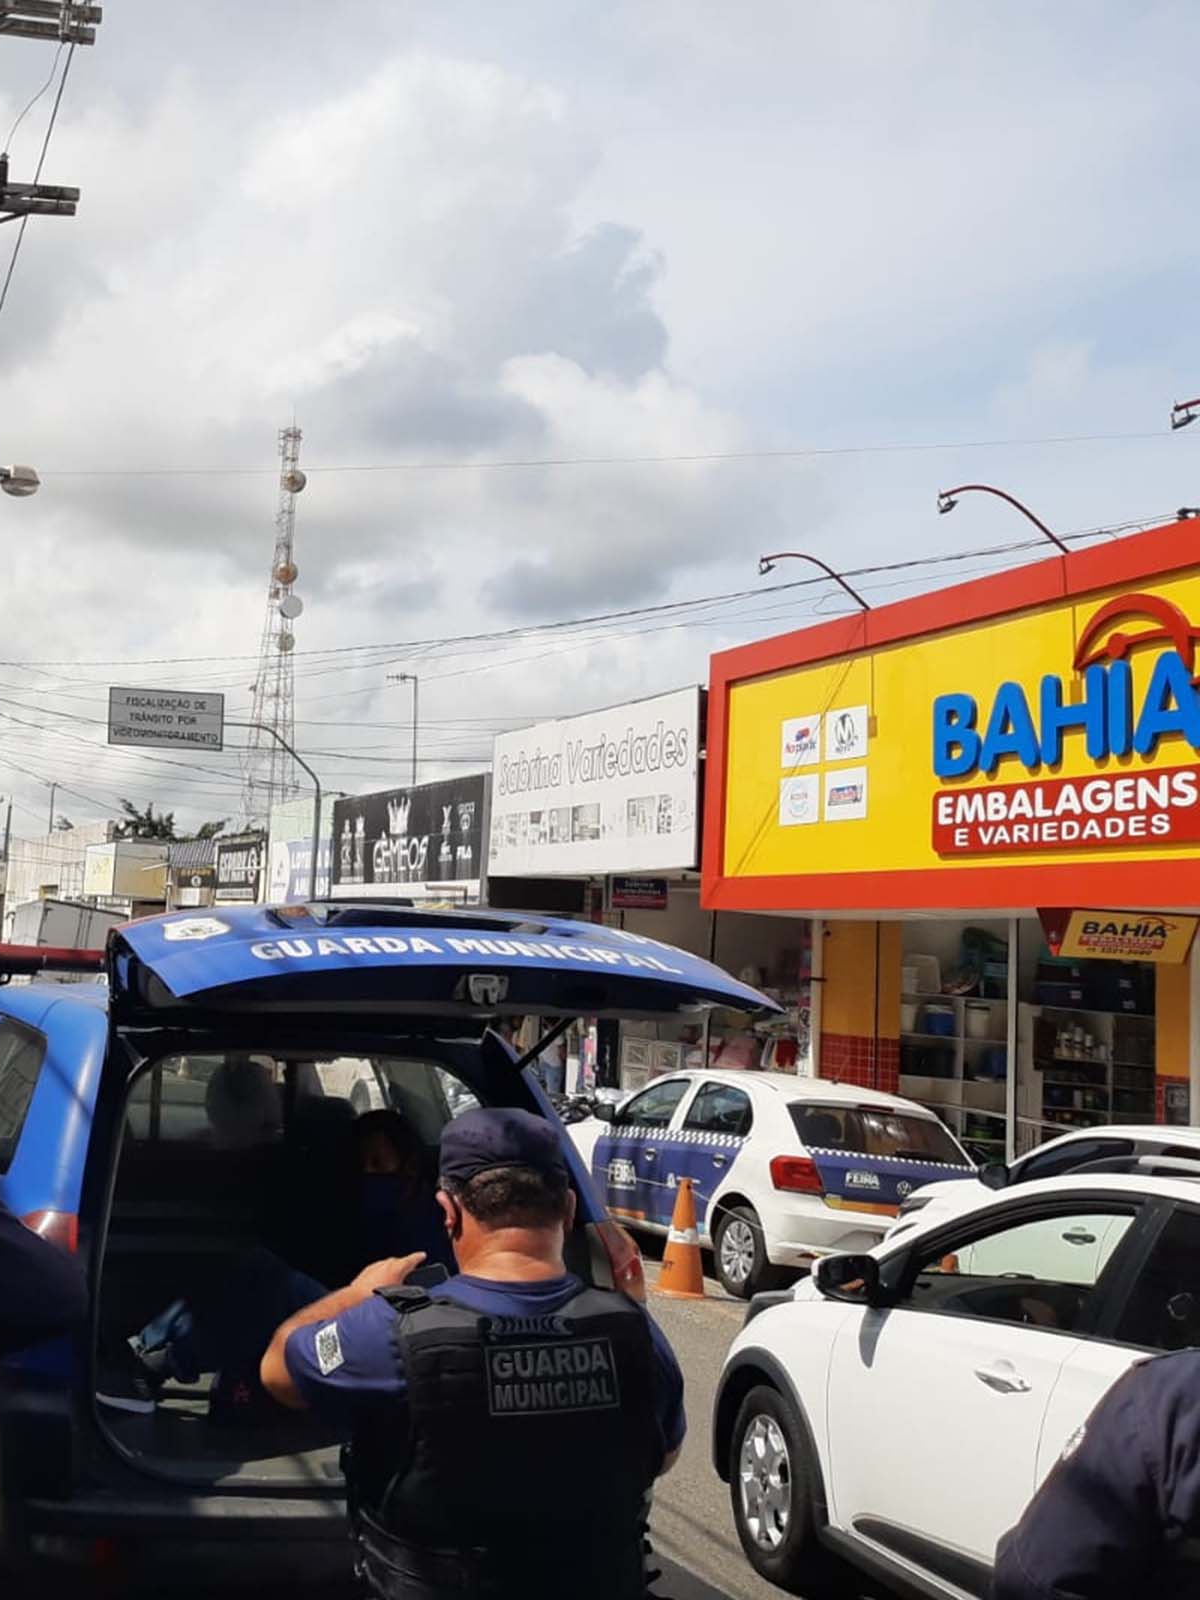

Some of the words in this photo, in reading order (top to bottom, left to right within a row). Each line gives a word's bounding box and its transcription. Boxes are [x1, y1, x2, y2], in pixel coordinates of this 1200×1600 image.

[125, 696, 191, 710] FISCALIZAÇÃO
[194, 700, 208, 710] DE
[129, 711, 174, 725] TRÂNSITO
[178, 715, 197, 725] POR
[933, 650, 1200, 779] BAHIA
[499, 746, 563, 796] Sabrina
[566, 720, 689, 785] Variedades
[937, 771, 1199, 825] EMBALAGENS
[954, 828, 969, 846] E
[978, 813, 1171, 845] VARIEDADES
[1081, 920, 1167, 938] BAHIA
[250, 935, 444, 961] GUARDA
[443, 936, 684, 975] MUNICIPAL
[491, 1343, 610, 1379] GUARDA
[493, 1377, 613, 1410] MUNICIPAL
